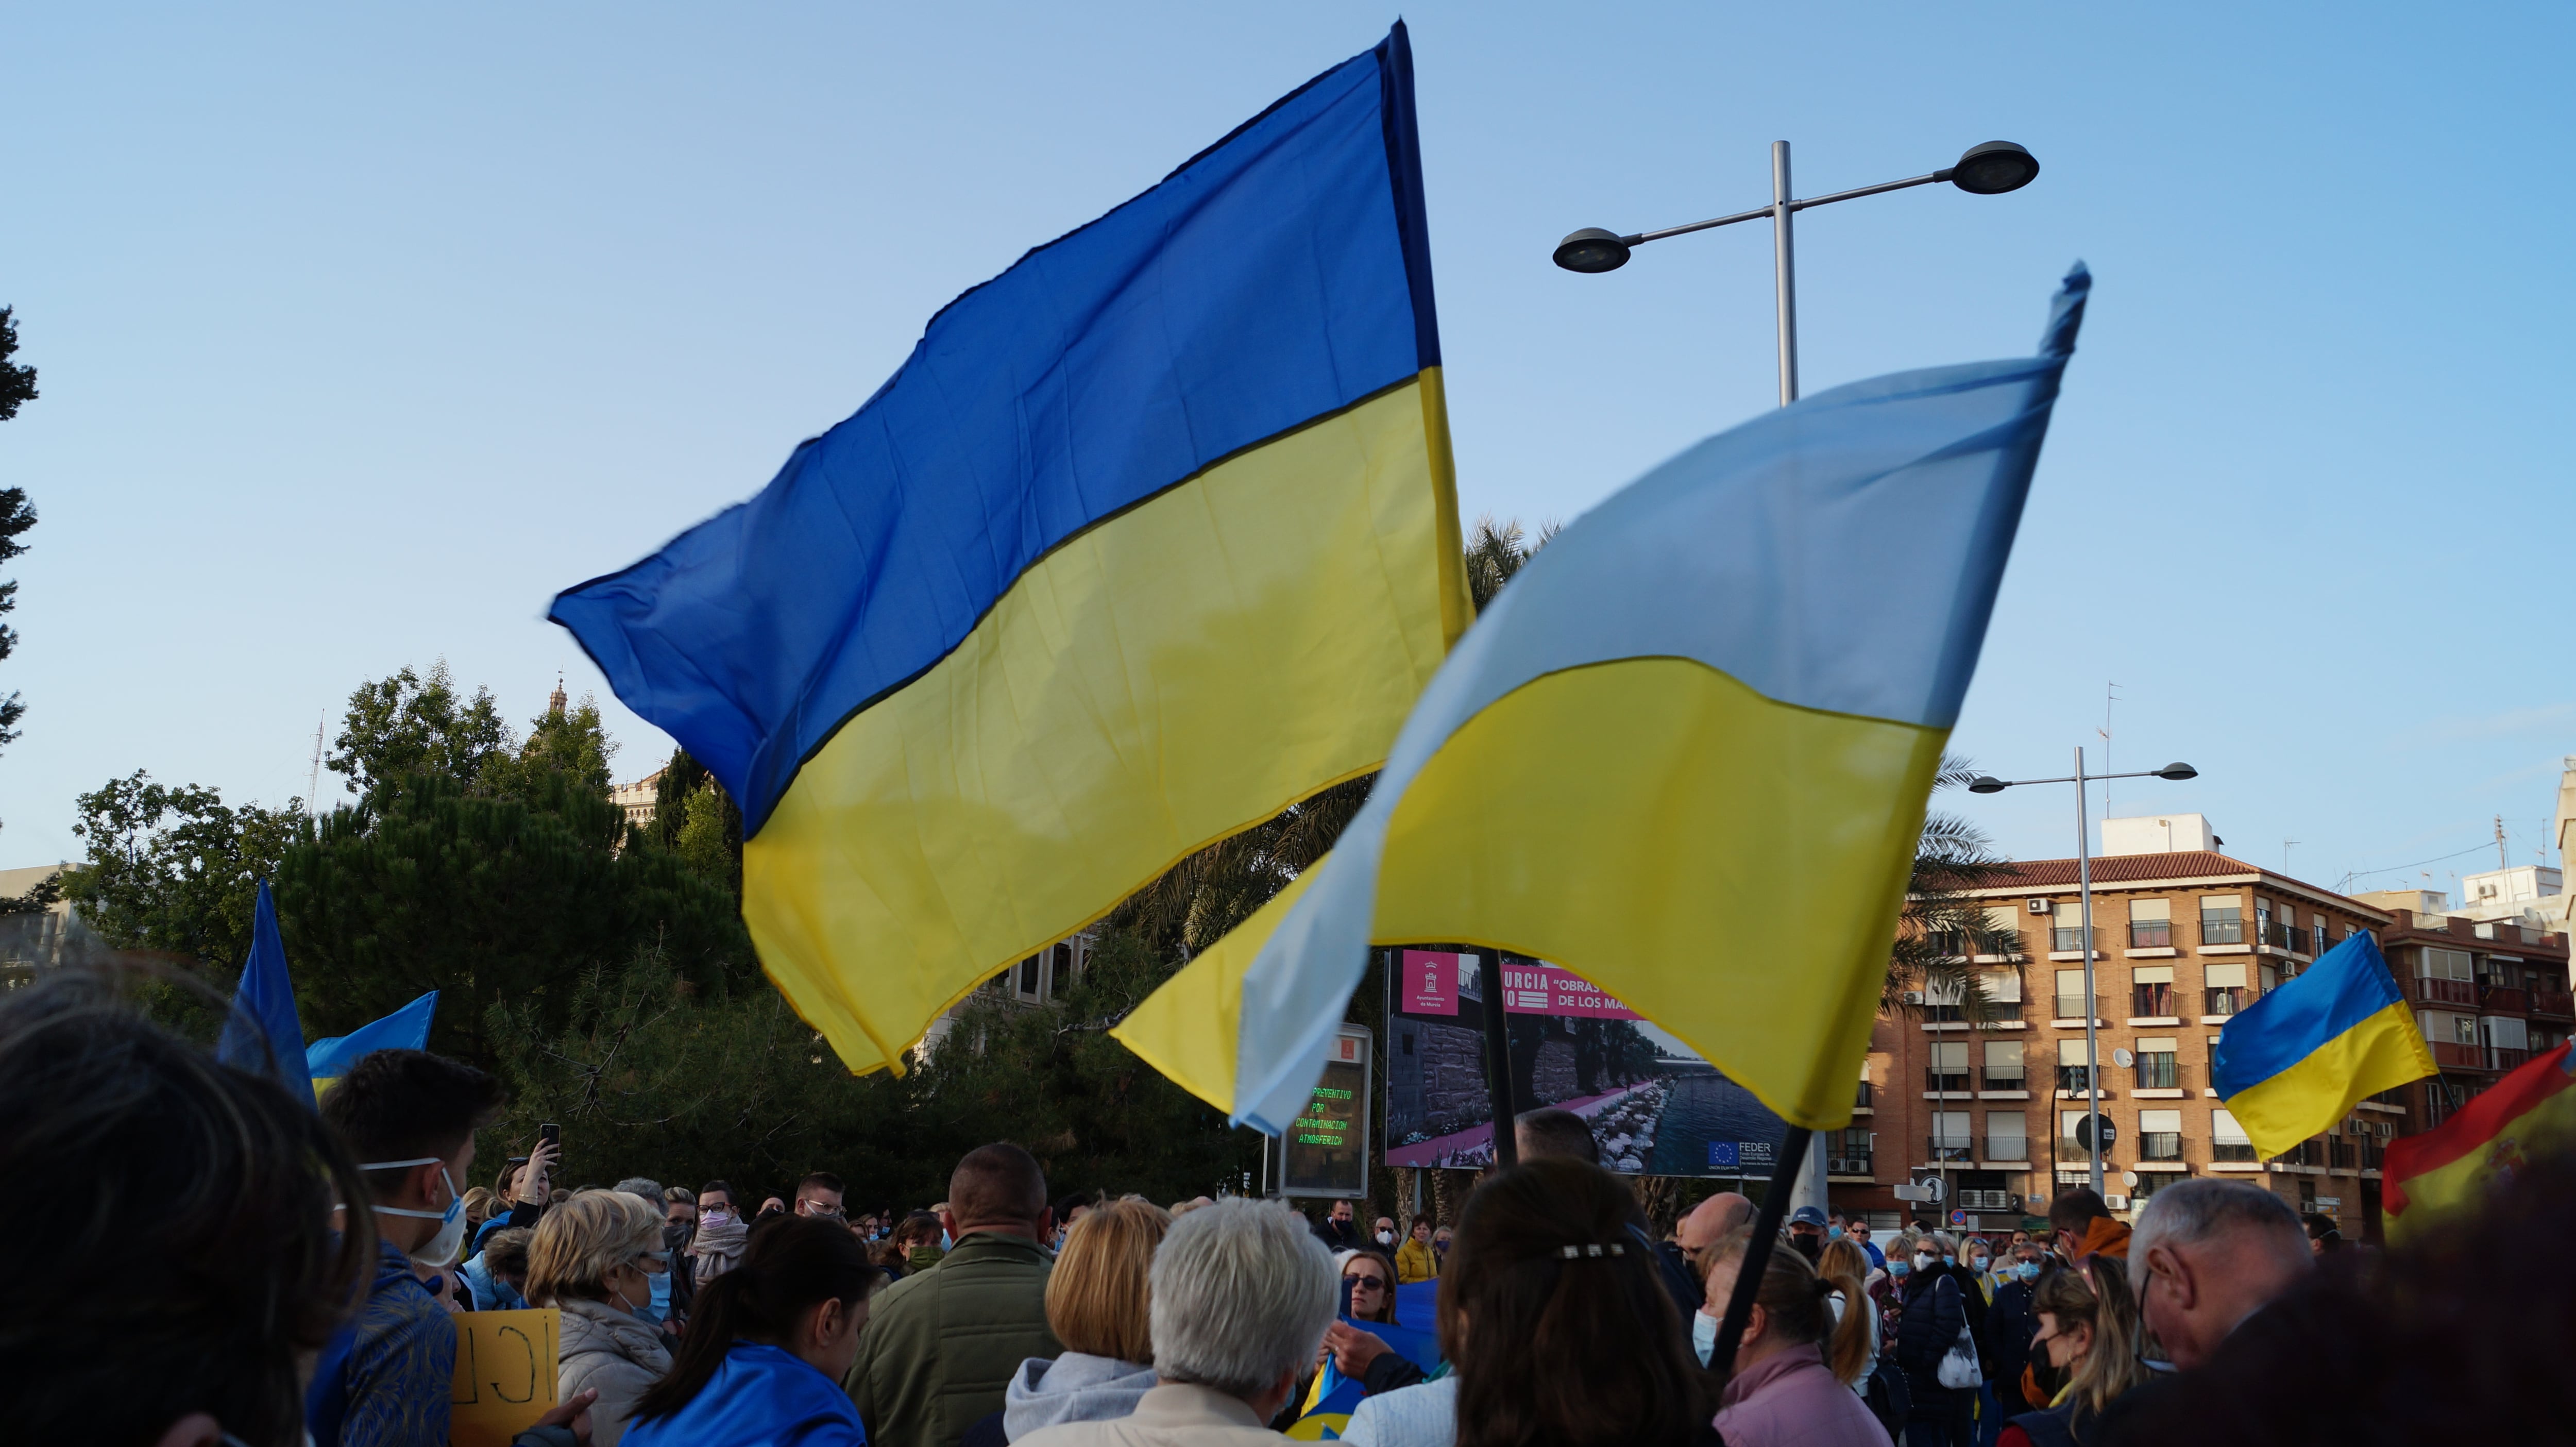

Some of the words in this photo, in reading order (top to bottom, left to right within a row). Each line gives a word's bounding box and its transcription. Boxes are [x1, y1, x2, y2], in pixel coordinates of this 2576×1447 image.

[1504, 971, 1548, 990] URCIA
[1558, 995, 1574, 1006] DE
[1578, 997, 1601, 1008] LOS
[1312, 1087, 1351, 1099] PREVENTIVO
[1312, 1103, 1325, 1113] POR
[1296, 1118, 1347, 1130] CONTAMINACION
[1299, 1134, 1343, 1145] ATMOSFERICA
[1739, 1142, 1771, 1152] FEDER
